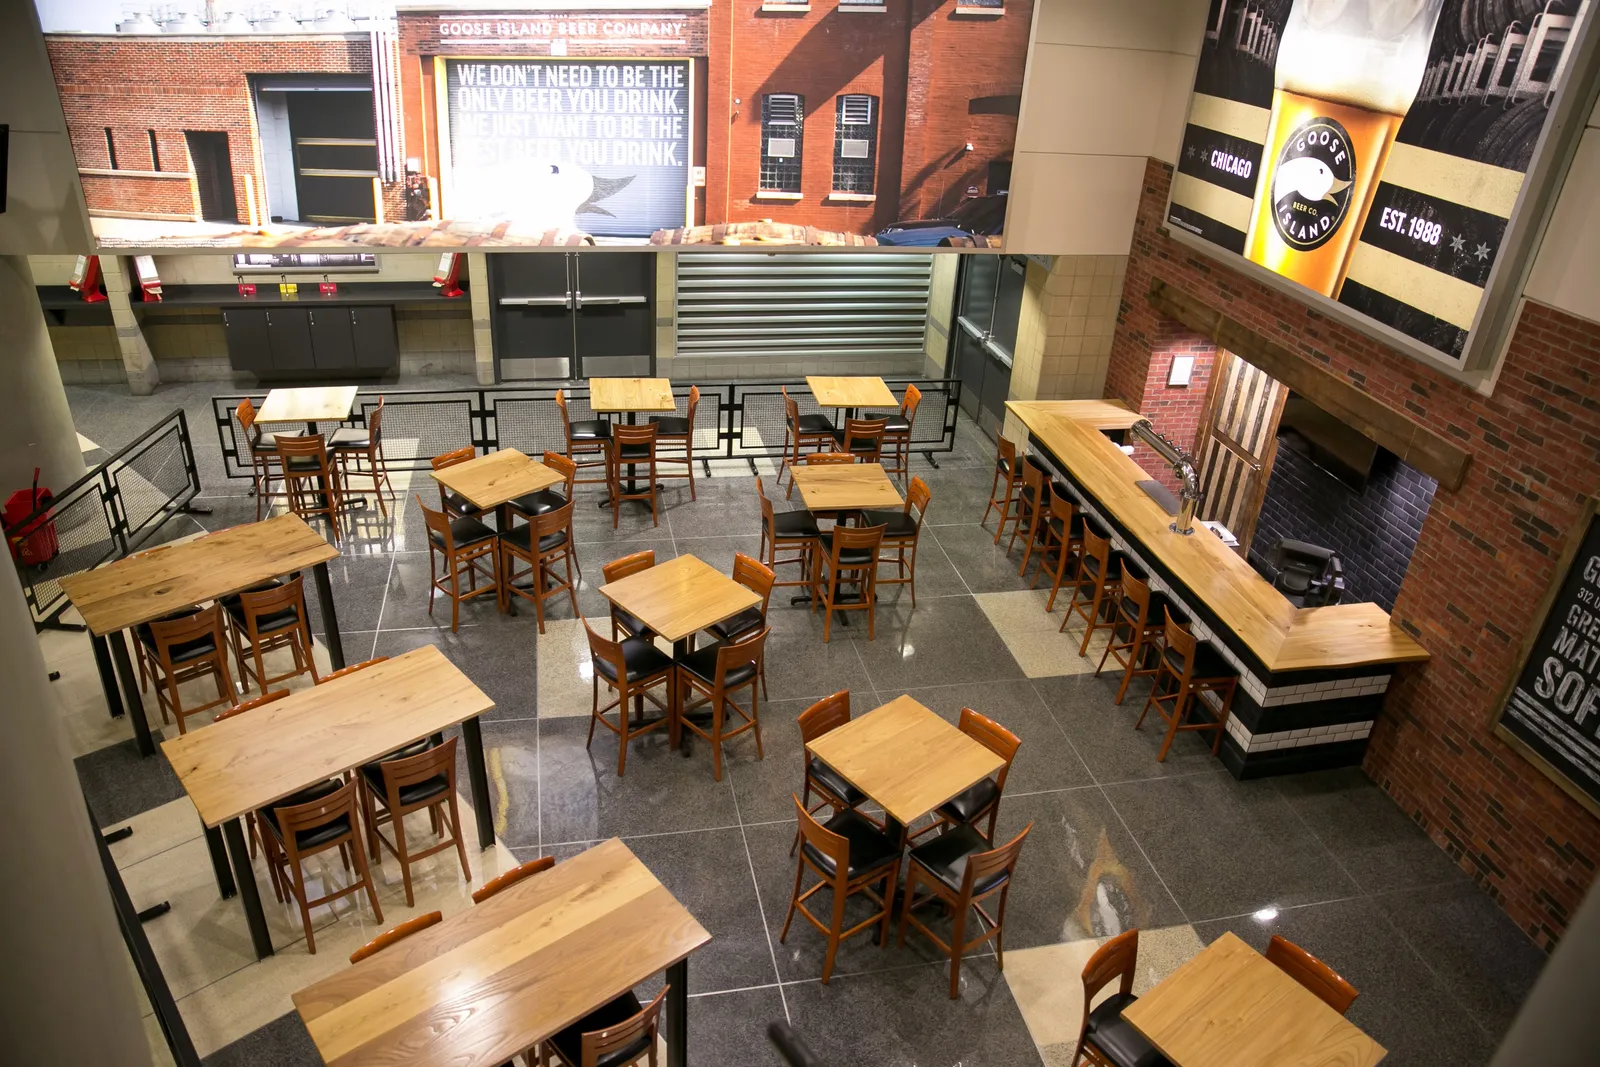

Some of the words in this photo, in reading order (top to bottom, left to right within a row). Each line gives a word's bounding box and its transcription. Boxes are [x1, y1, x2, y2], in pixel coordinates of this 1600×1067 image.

[439, 22, 491, 36] GOOSE
[497, 22, 551, 36] ISLAND
[558, 22, 597, 36] BEER
[602, 22, 682, 36] COMPANY
[457, 64, 487, 86] WE
[490, 65, 542, 87] DON'T
[546, 65, 592, 88] NEED
[595, 66, 618, 88] TO
[622, 66, 646, 88] BE
[651, 66, 684, 88] THE
[457, 87, 509, 112] ONLY
[512, 88, 563, 113] BEER
[567, 89, 608, 113] YOU
[613, 89, 684, 115] DRINK.
[491, 113, 531, 137] JUST
[537, 114, 588, 138] WANT
[593, 115, 617, 138] TO
[622, 115, 645, 139] BE
[649, 116, 683, 139] THE
[566, 140, 608, 165] YOU
[613, 141, 683, 166] DRINK.
[1296, 130, 1347, 166] GOOSE
[1210, 149, 1253, 179] CHICAGO
[1292, 200, 1308, 213] BEER
[1308, 206, 1319, 217] CO.
[1279, 204, 1331, 240] ISLAND
[1379, 206, 1407, 235] EST.
[1408, 216, 1442, 246] 1988
[1577, 587, 1594, 605] 312
